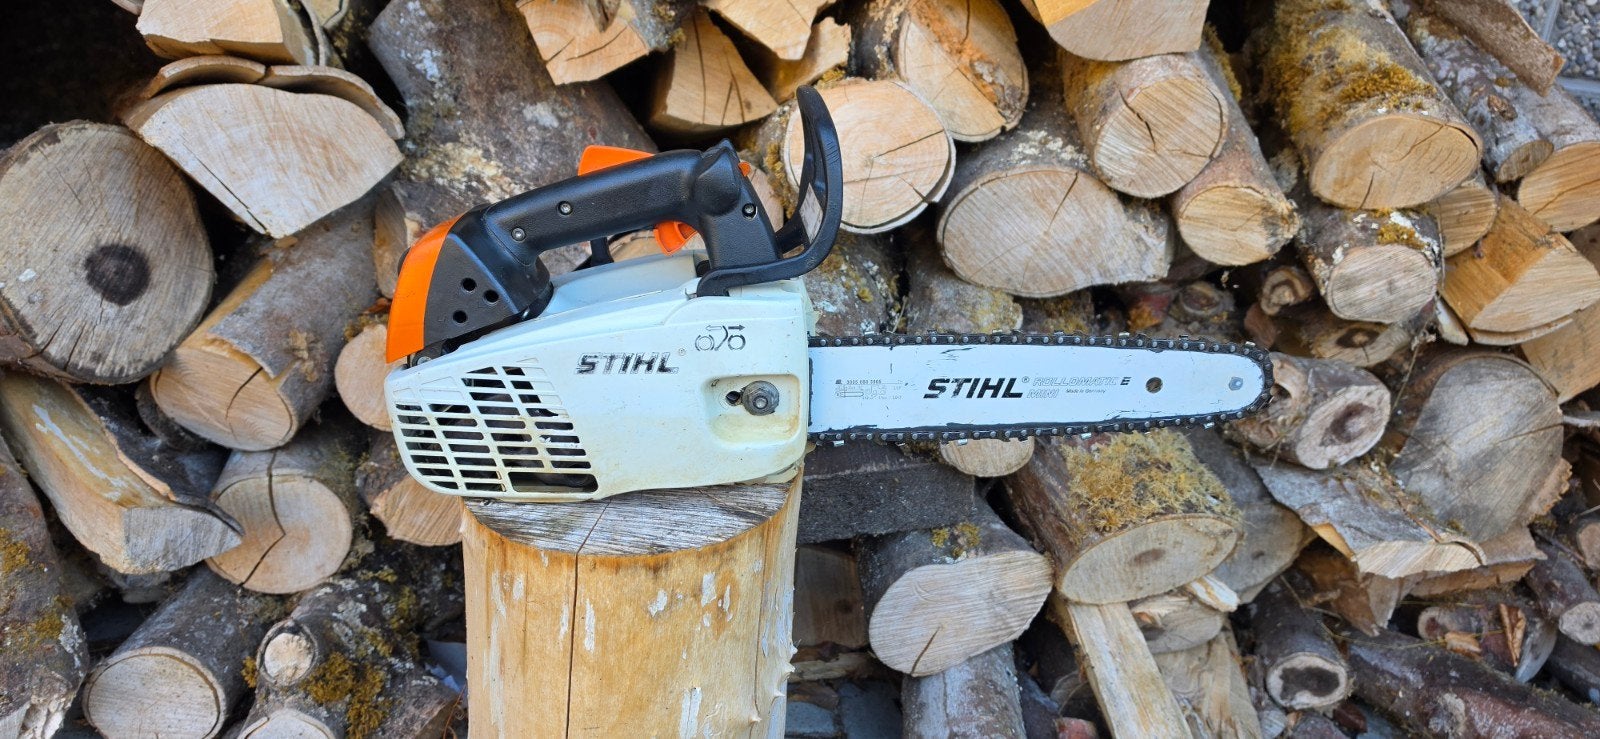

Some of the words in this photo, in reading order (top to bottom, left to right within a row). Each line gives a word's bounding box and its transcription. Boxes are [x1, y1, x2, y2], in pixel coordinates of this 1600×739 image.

[576, 352, 679, 374] STIHL
[923, 377, 1023, 398] STIHL
[1033, 376, 1117, 386] ROLLOMATIC
[1120, 377, 1132, 385] E
[1026, 388, 1059, 398] MINI
